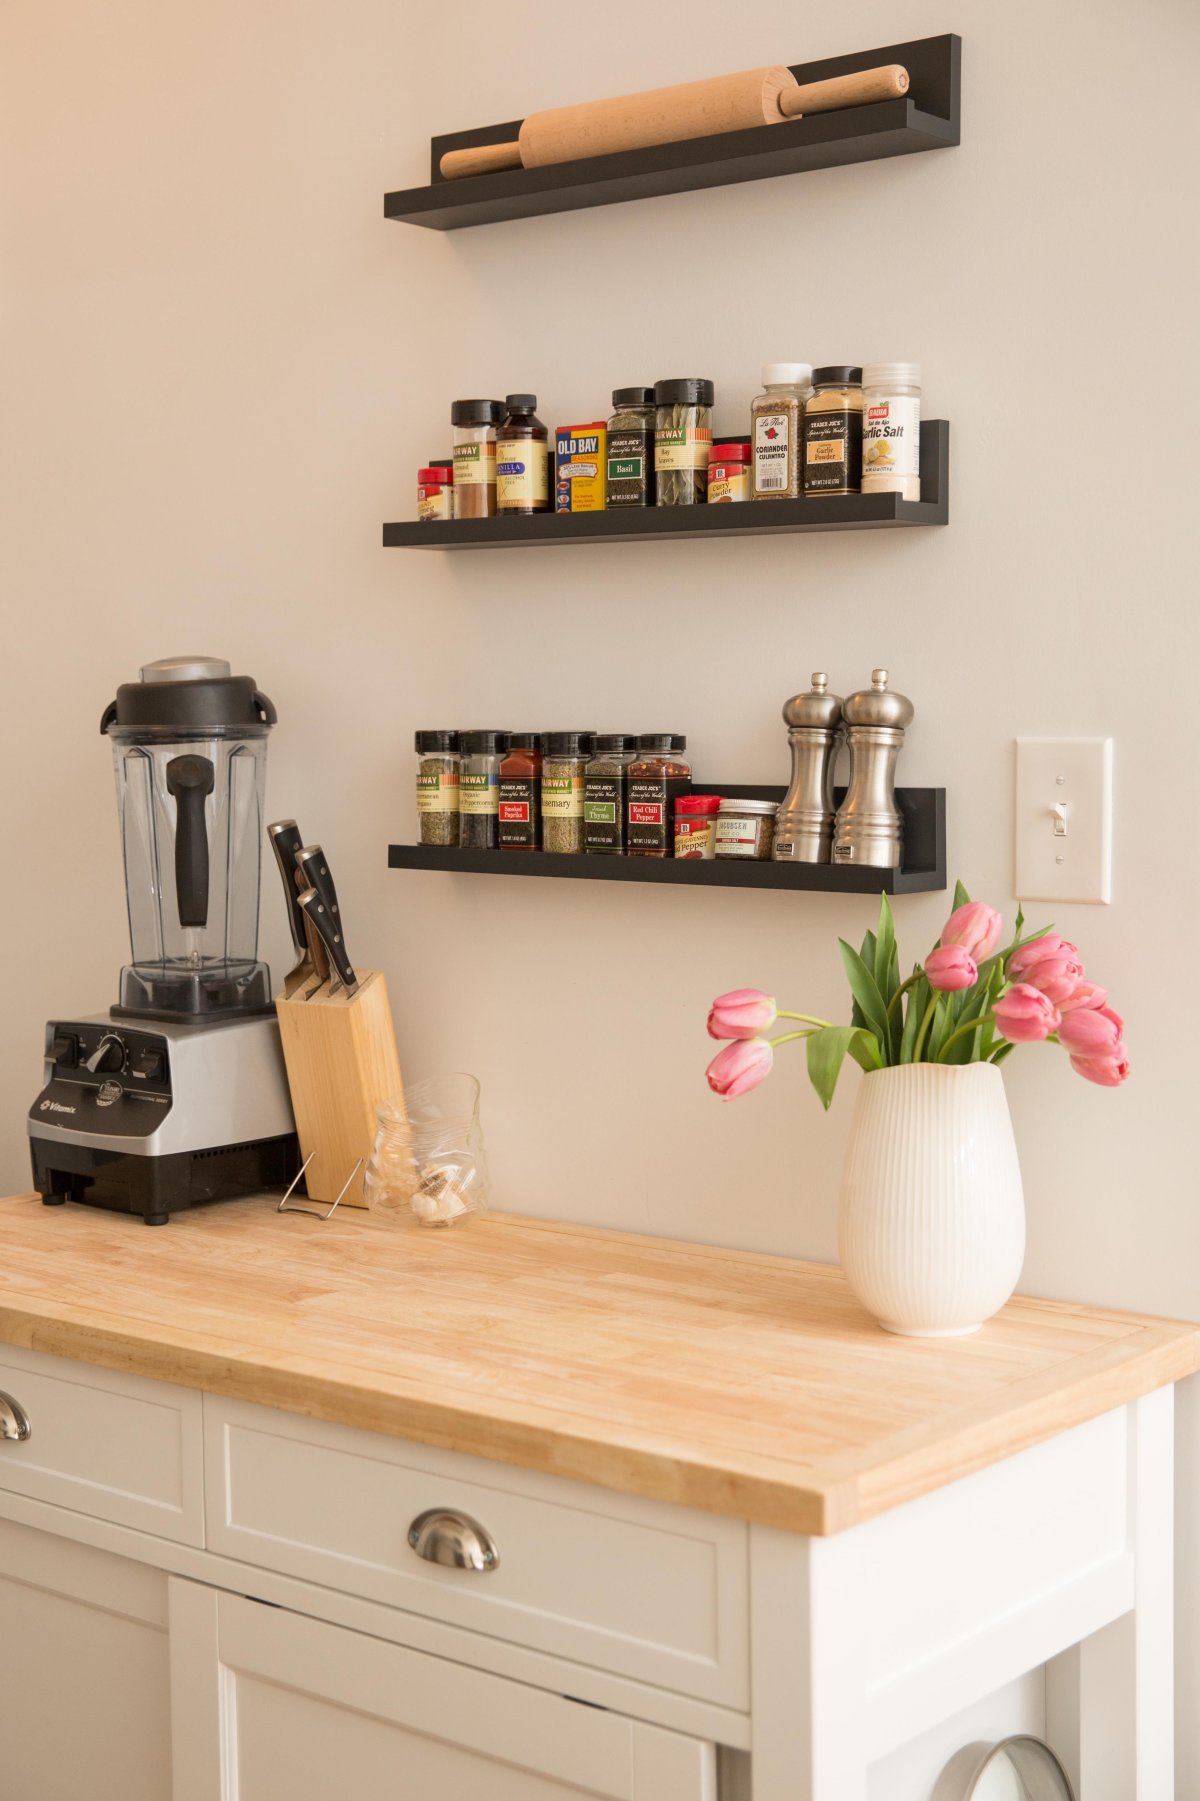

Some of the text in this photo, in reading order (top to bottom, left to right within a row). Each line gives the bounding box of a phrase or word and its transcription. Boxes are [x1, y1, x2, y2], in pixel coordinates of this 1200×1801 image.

[883, 426, 904, 438] Salt
[558, 438, 597, 455] OLD BAY
[756, 444, 788, 454] CORIANDER
[617, 464, 633, 473] Basil
[590, 812, 610, 820] Thyme
[682, 841, 707, 852] Pepper
[49, 1102, 76, 1114] Vitamix
